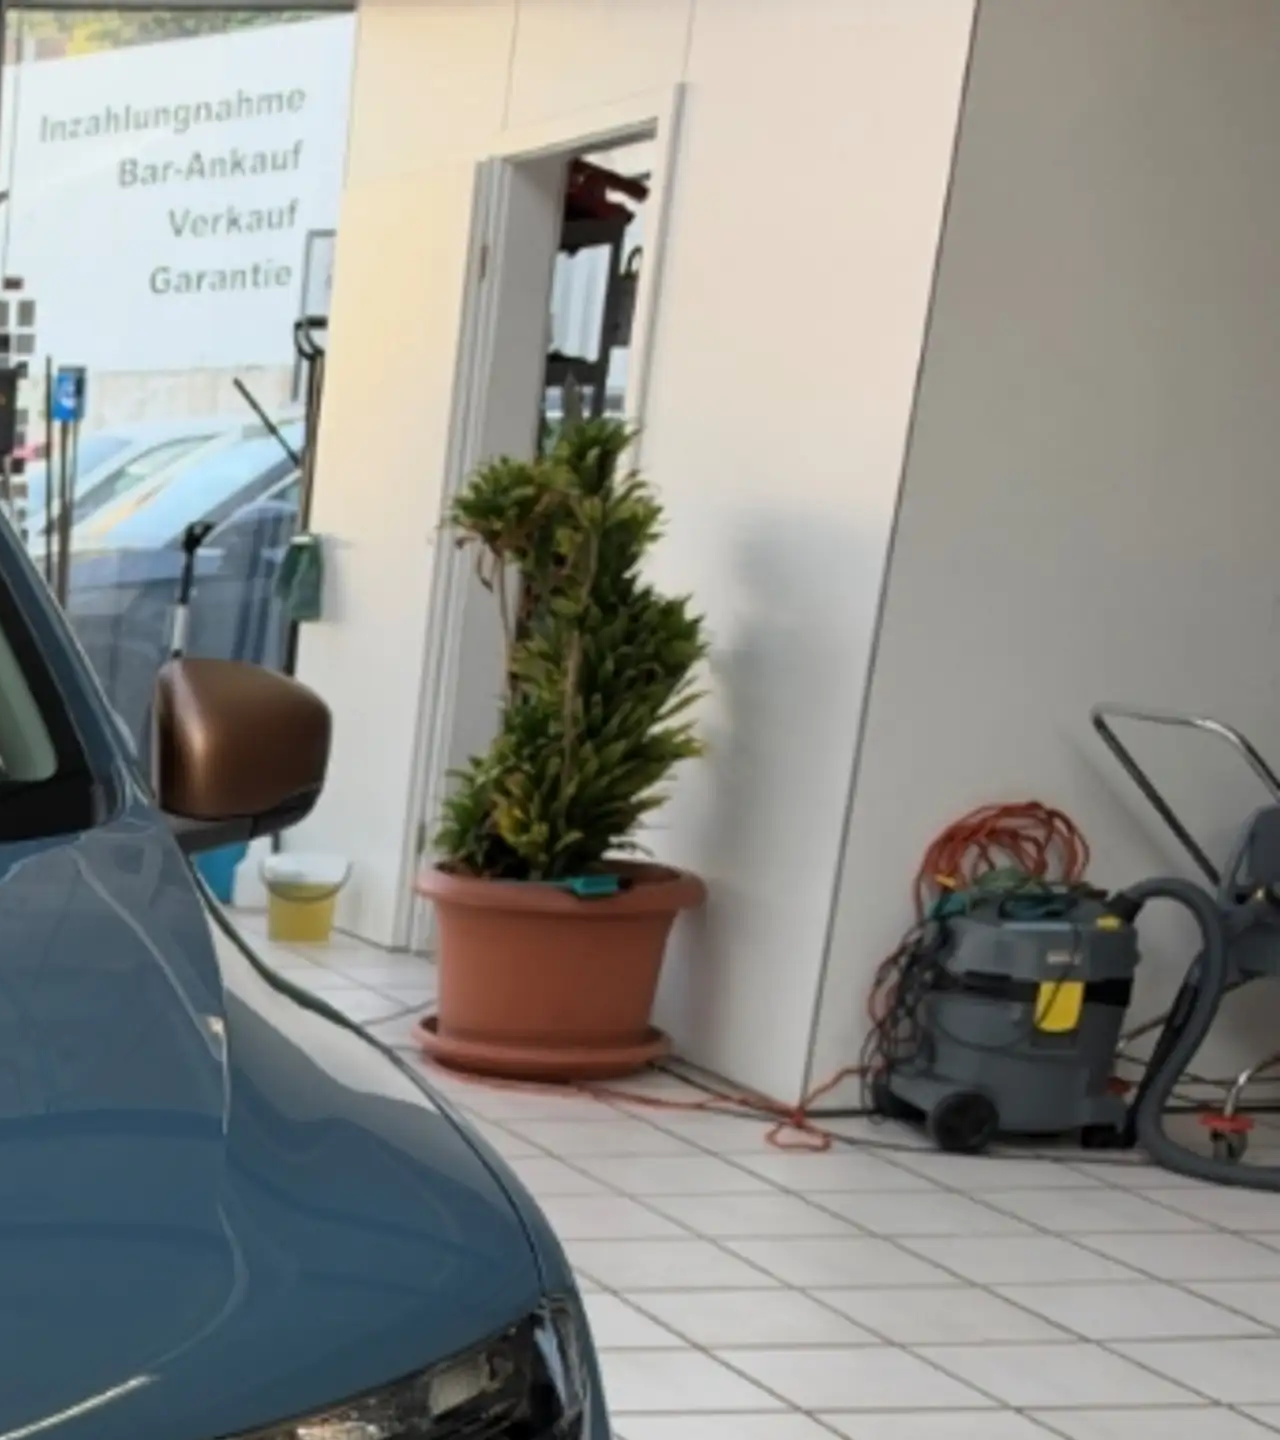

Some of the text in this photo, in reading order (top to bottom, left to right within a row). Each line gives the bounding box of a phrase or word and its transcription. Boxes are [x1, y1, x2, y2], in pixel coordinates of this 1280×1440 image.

[39, 88, 306, 143] Inzahlungnahme
[118, 138, 304, 188] Bar-Ankauf
[167, 197, 299, 238] Verkauf
[148, 260, 293, 295] Garantie
